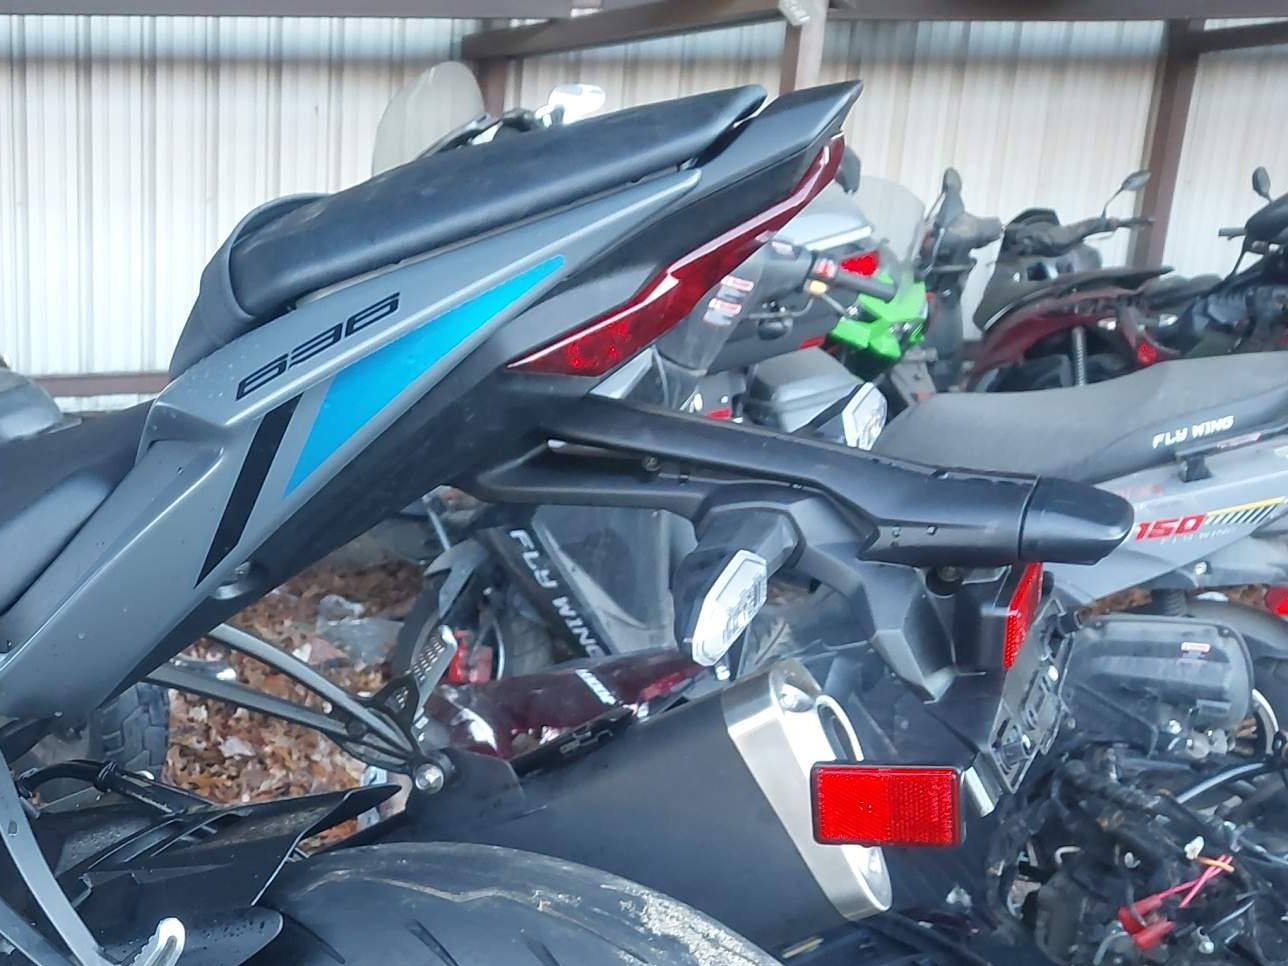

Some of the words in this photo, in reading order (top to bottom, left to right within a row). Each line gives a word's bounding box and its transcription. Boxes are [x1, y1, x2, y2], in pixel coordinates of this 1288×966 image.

[235, 292, 401, 401] 636
[1152, 427, 1188, 449] FLY
[1192, 415, 1234, 438] WING
[1136, 513, 1206, 540] 150
[509, 529, 558, 588] FLY
